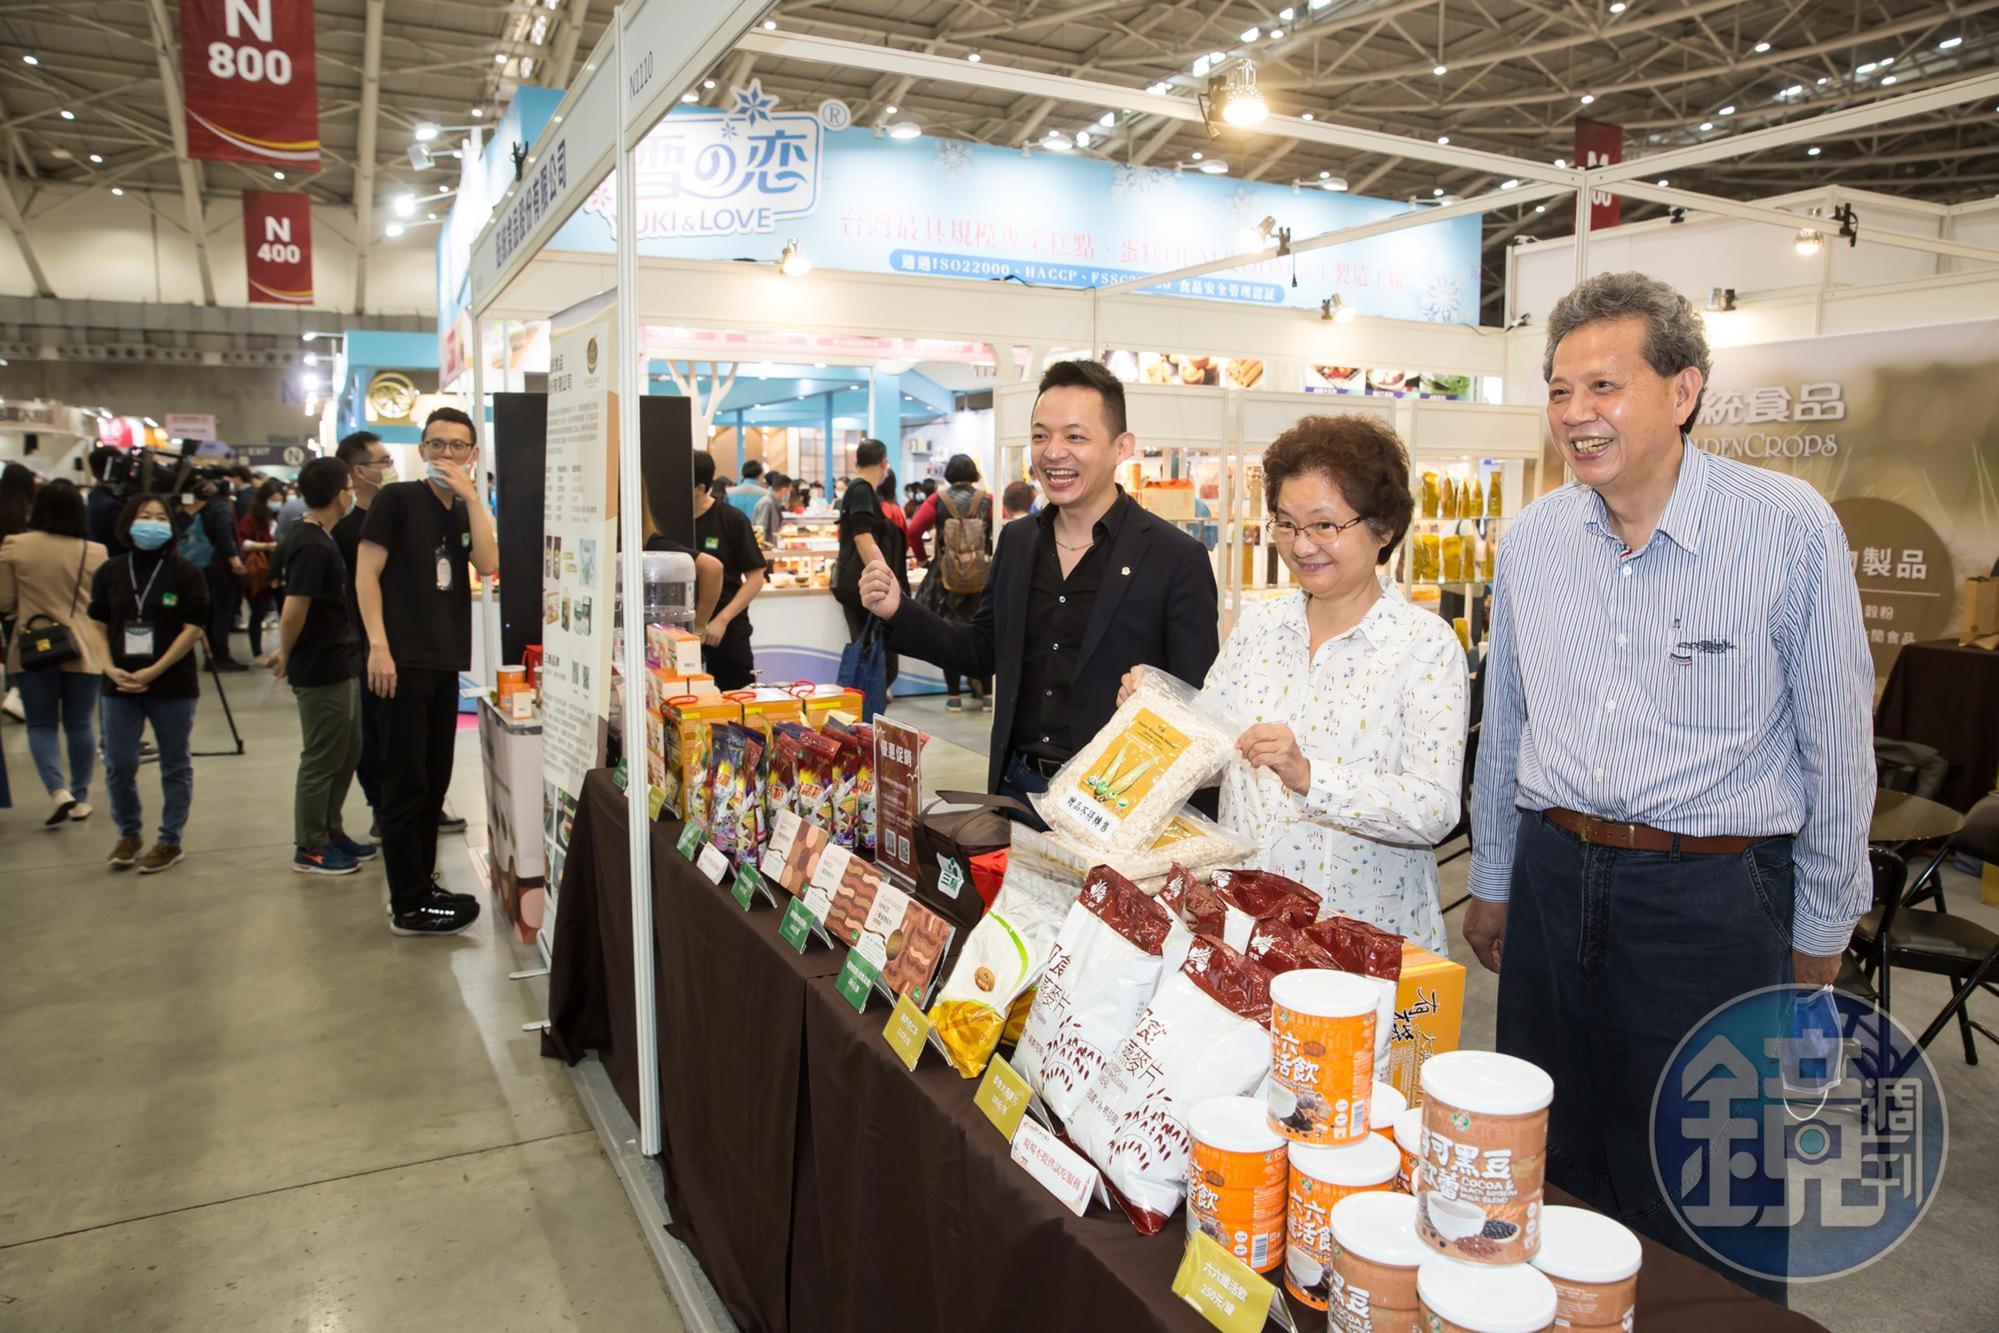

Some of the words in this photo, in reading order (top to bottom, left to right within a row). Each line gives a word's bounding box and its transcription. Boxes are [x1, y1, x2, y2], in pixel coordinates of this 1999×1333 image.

[225, 0, 272, 42] N
[207, 42, 292, 86] 800
[629, 50, 654, 102] N1110
[264, 215, 292, 243] N
[681, 215, 696, 231] &
[700, 208, 771, 230] LOVE
[257, 241, 301, 264] 400
[1461, 1176, 1504, 1190] COCOA
